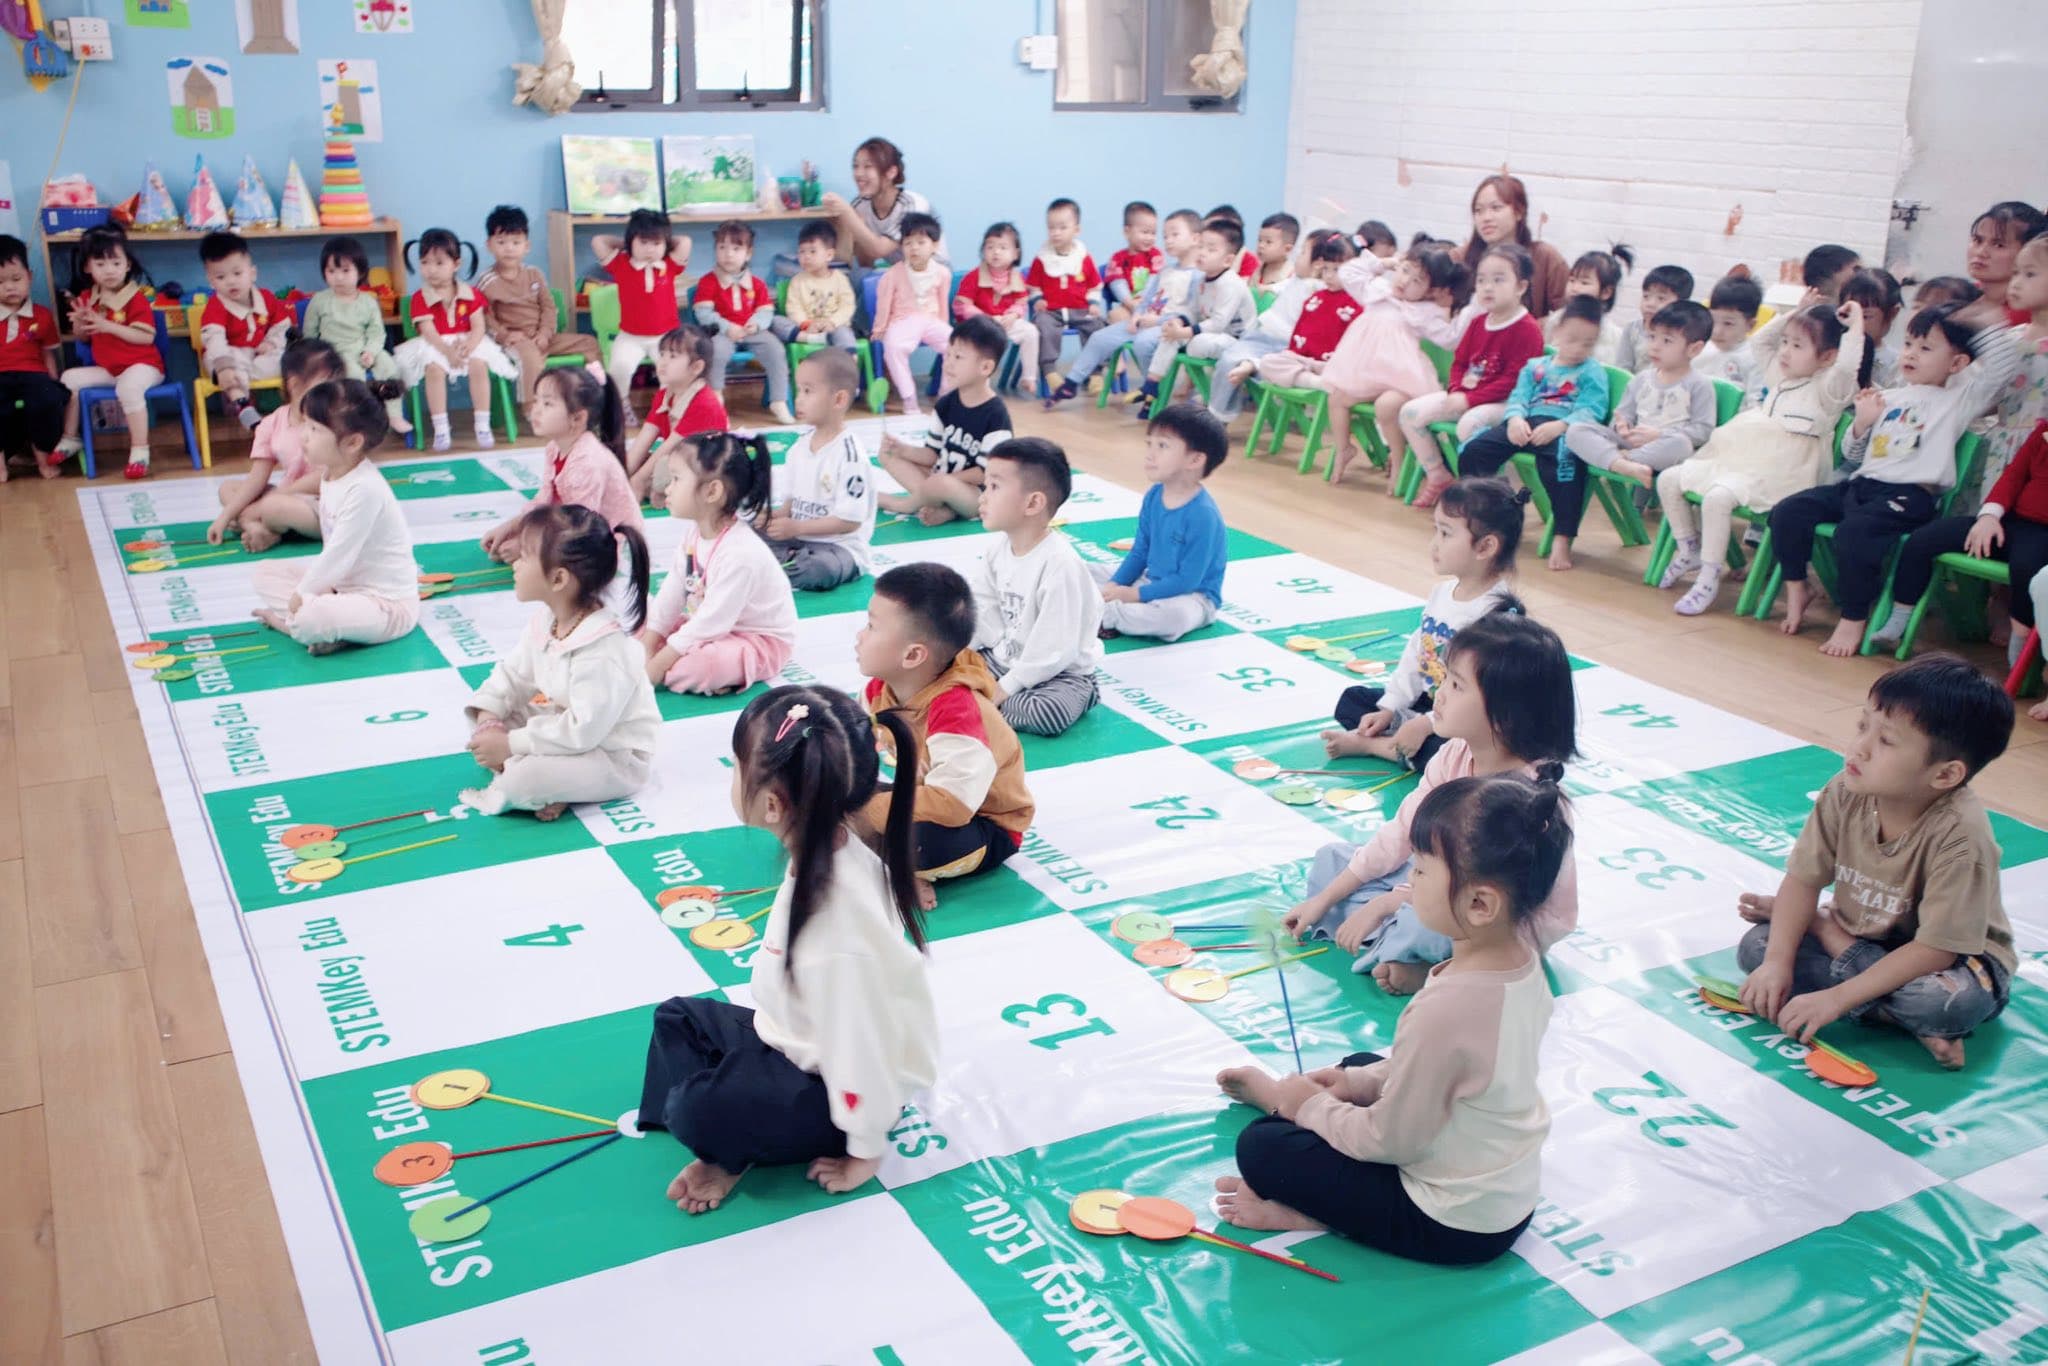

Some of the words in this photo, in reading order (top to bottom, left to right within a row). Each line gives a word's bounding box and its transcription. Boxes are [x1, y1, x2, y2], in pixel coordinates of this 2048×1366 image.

[1216, 666, 1296, 693] 35
[363, 709, 430, 725] 6
[1112, 687, 1209, 732] STEMKey
[1599, 703, 1680, 729] 44
[248, 794, 292, 825] Edu
[1128, 794, 1223, 831] 24
[652, 847, 704, 885] Edu
[1598, 847, 1707, 891] 33
[297, 916, 349, 952] Edu
[502, 922, 585, 947] 4
[316, 954, 391, 1054] STEMKey
[1000, 992, 1118, 1051] 13
[366, 1083, 430, 1141] Edu
[1592, 1070, 1739, 1149] 22
[401, 1154, 436, 1169] 3
[961, 1194, 1047, 1265] Edu
